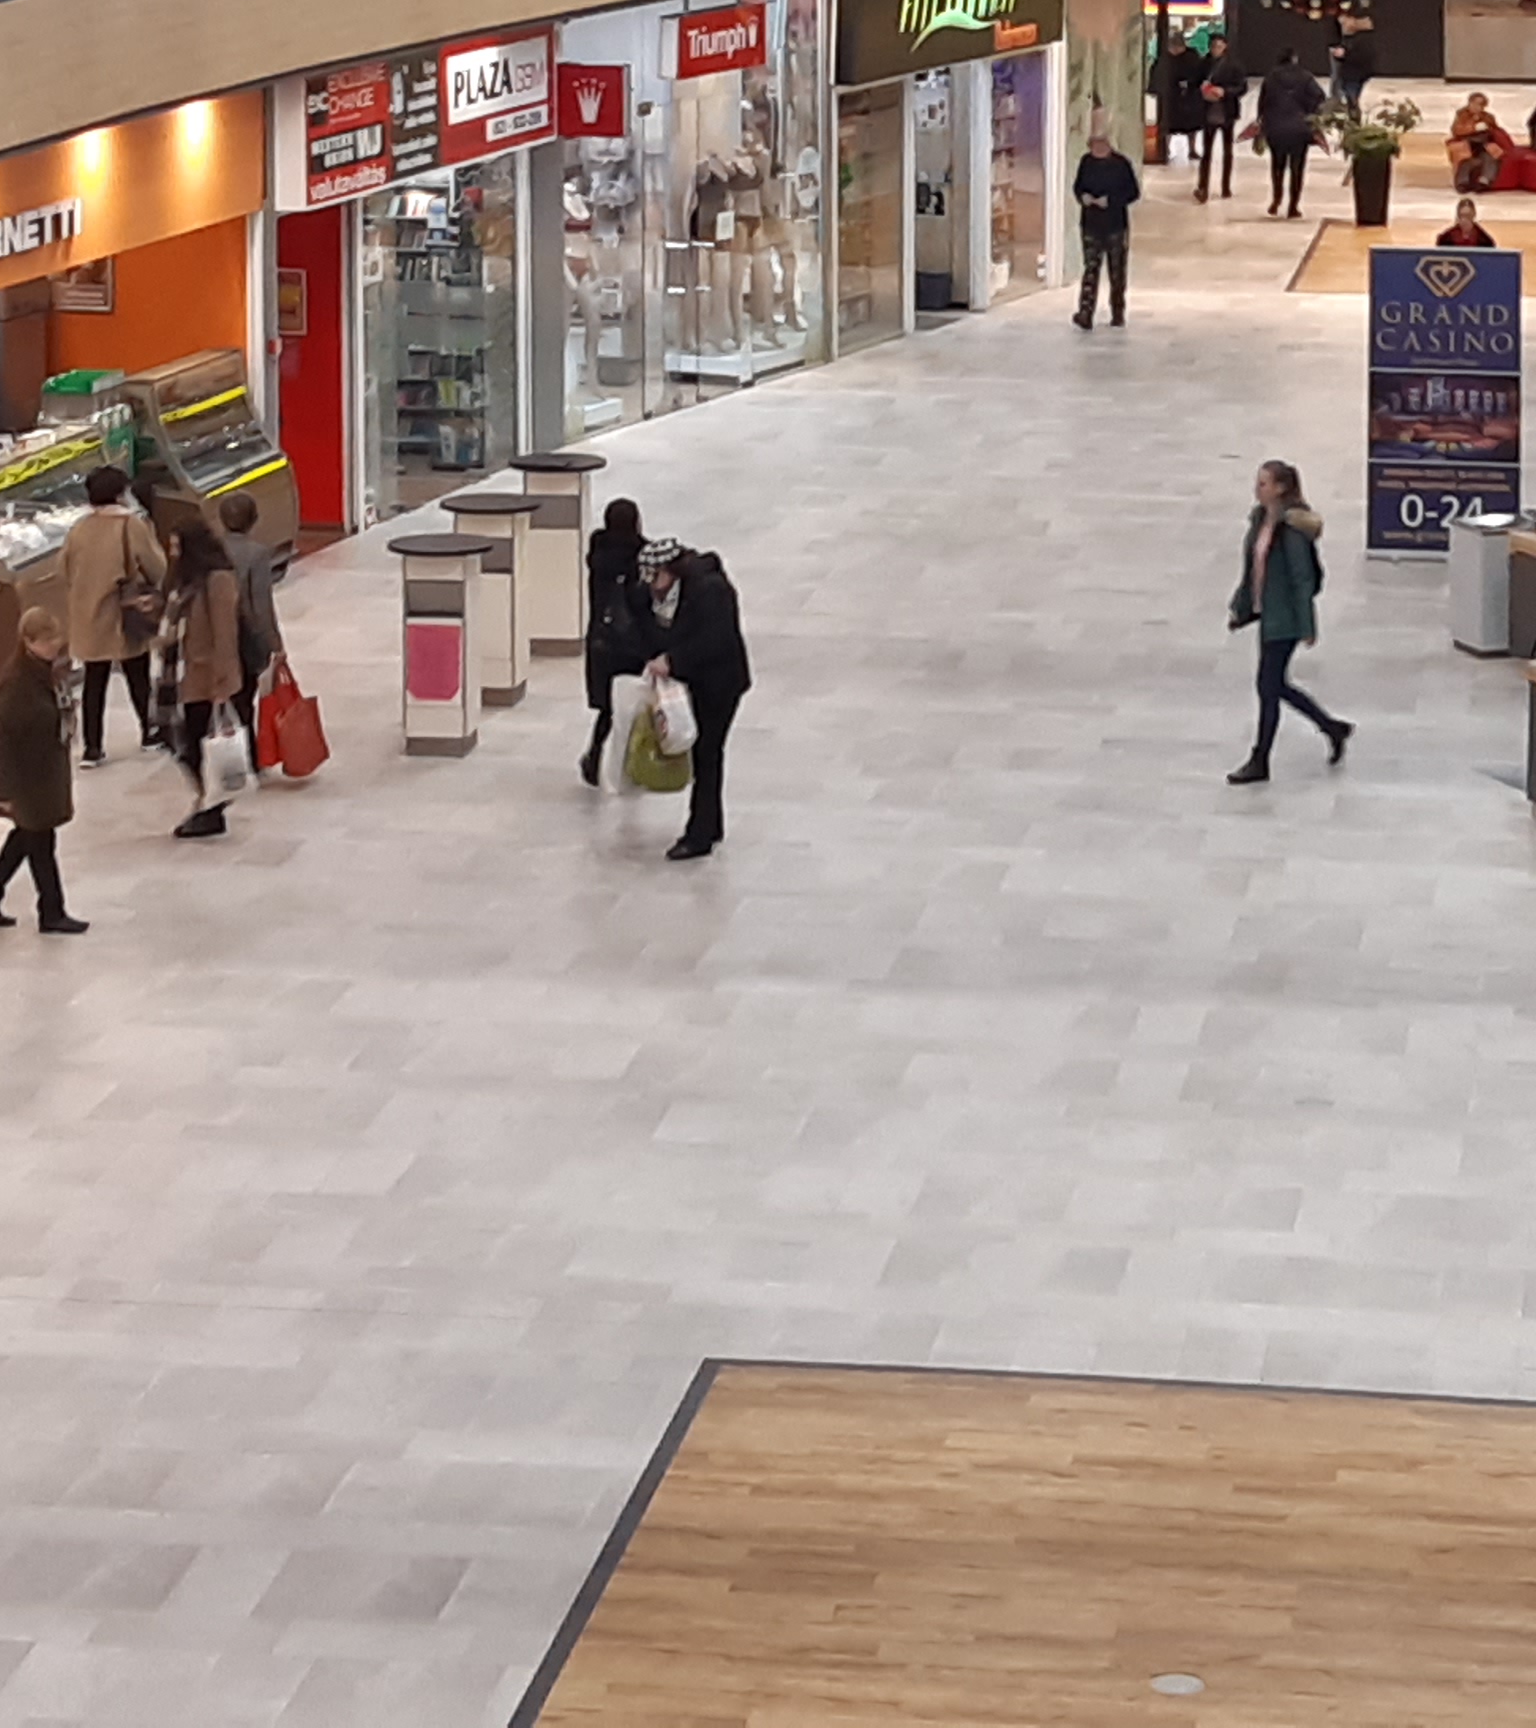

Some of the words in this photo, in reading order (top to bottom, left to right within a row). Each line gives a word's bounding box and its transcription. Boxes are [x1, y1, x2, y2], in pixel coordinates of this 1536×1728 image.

[687, 22, 746, 60] Triumph
[454, 57, 513, 109] PLAZA
[1380, 302, 1510, 326] GRAND
[1375, 328, 1514, 354] CASINO
